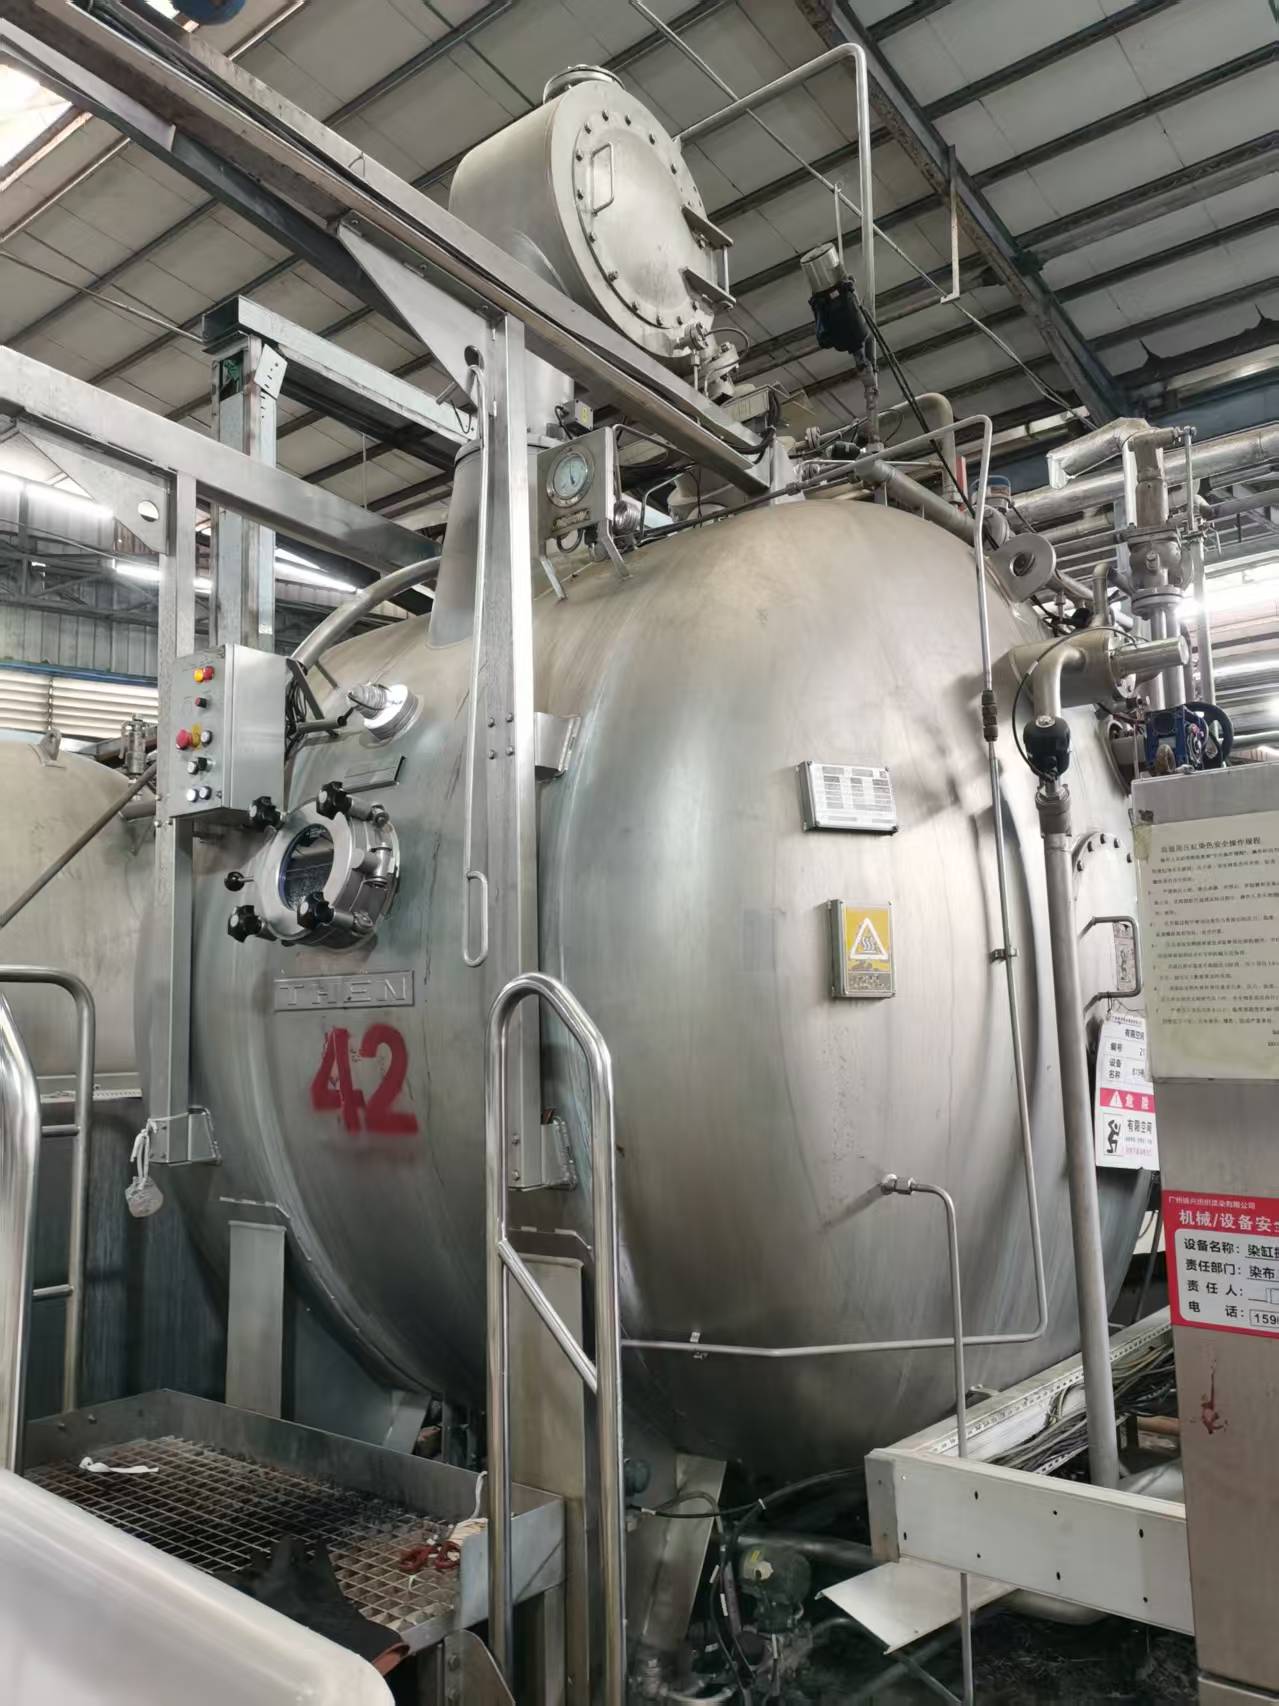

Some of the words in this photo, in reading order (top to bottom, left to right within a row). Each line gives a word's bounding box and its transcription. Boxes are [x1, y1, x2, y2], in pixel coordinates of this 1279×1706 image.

[279, 976, 407, 1006] THEN
[310, 1023, 418, 1136] 42
[1254, 1313, 1279, 1325] 159
